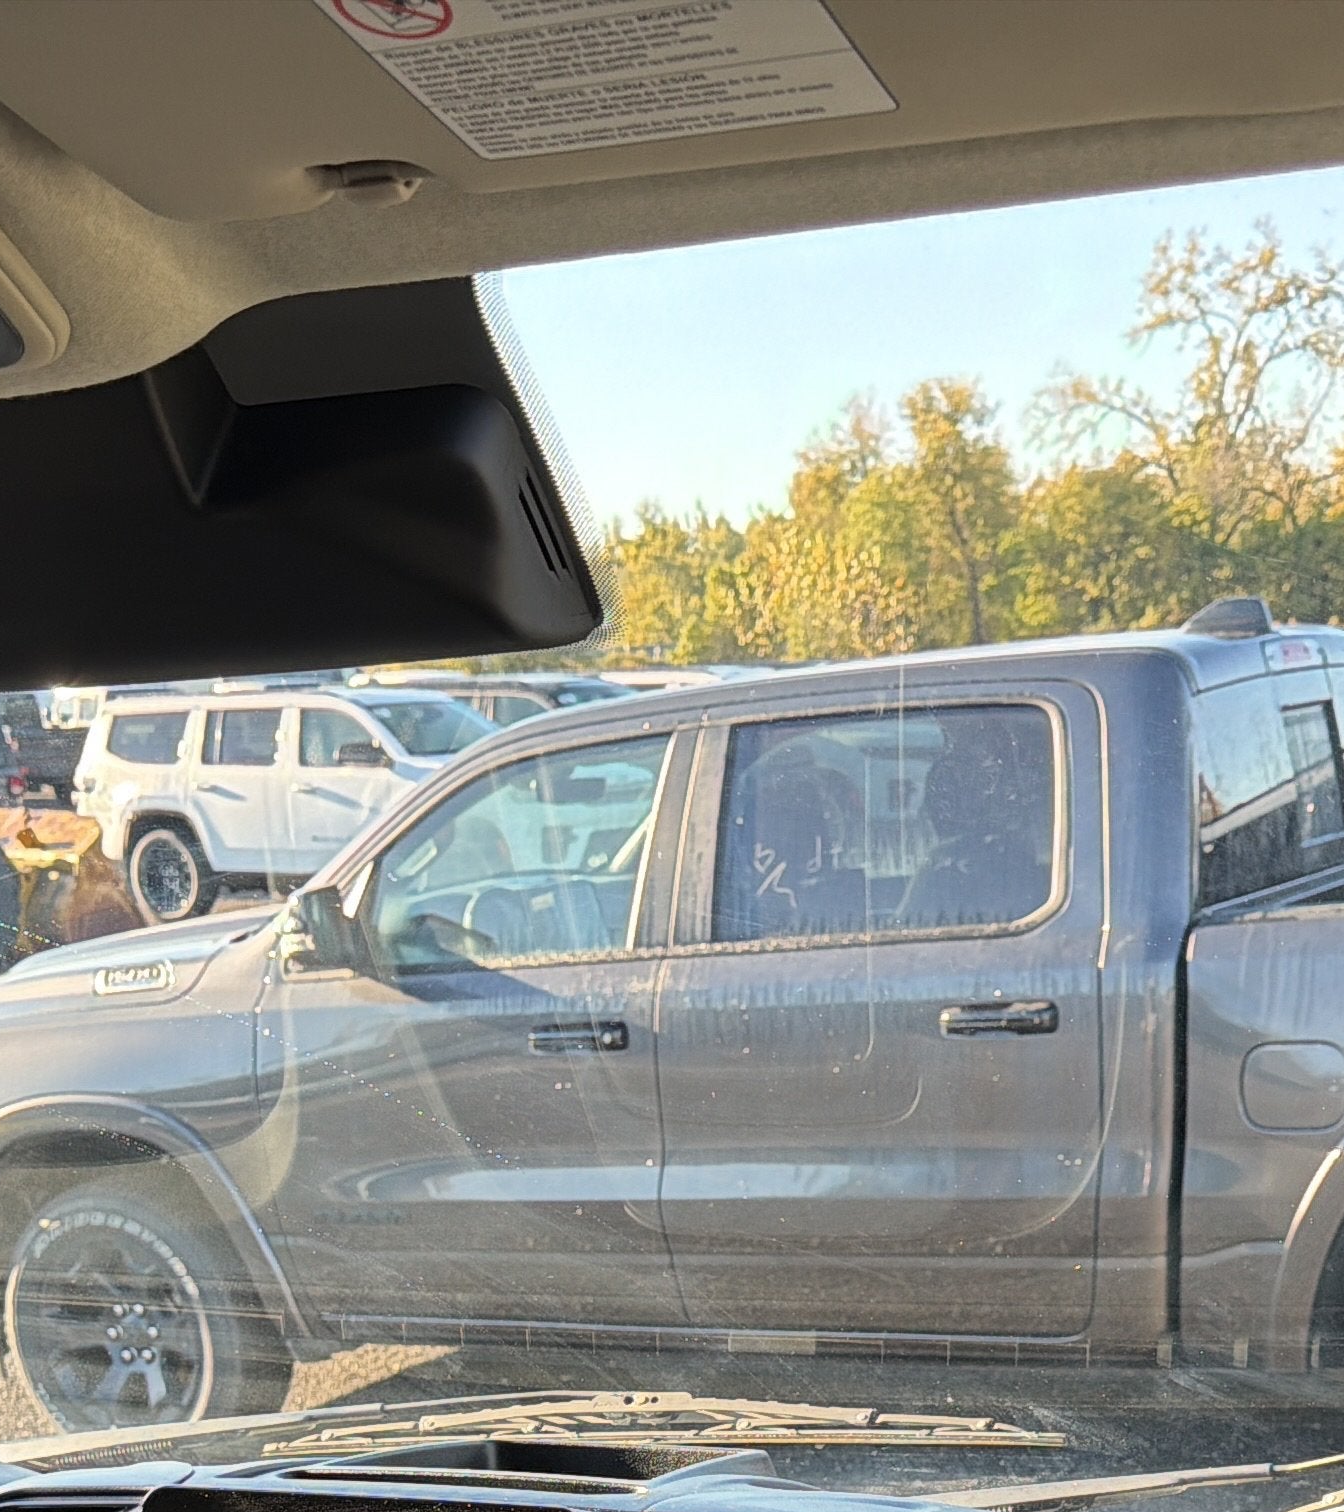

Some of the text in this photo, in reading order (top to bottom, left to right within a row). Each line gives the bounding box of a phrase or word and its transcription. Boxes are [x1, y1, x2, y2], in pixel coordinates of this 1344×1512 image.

[456, 29, 548, 50] BLESSURES
[549, 20, 611, 36] GRAVES
[636, 0, 734, 24] MORTELLES
[527, 87, 586, 104] MUERTE
[602, 79, 646, 94] SERIA
